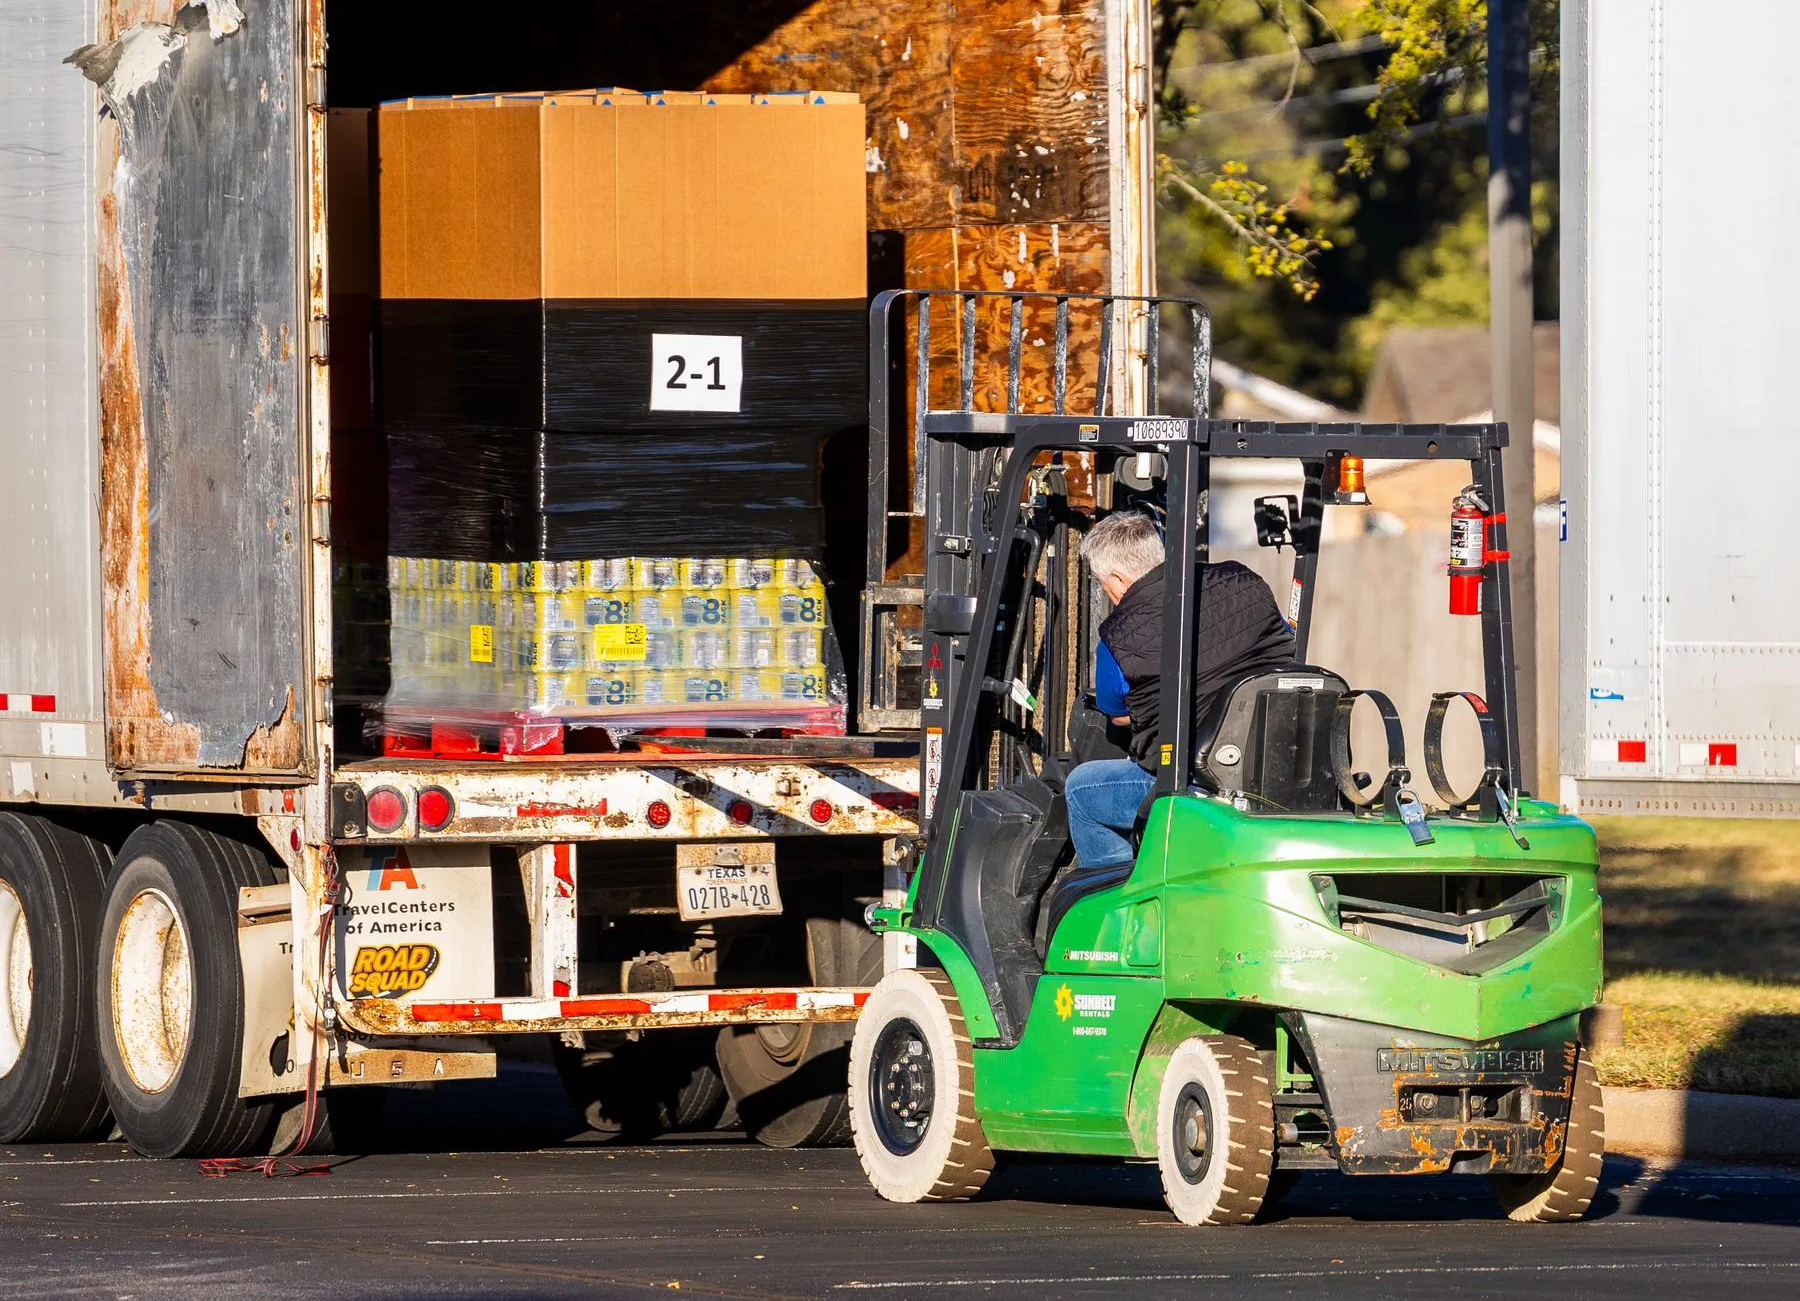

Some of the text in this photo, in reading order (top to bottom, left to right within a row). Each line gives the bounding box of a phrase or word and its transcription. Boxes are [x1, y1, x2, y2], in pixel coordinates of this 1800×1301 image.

[666, 354, 726, 390] 2-1
[1135, 420, 1187, 440] 10689390
[605, 600, 623, 625] 8
[702, 598, 721, 625] 8
[800, 597, 816, 623] 8
[606, 680, 625, 706] 8
[363, 845, 419, 891] TA
[707, 867, 746, 879] TEXAS
[725, 877, 749, 885] TRAILER
[334, 900, 455, 916] TravelCenters
[688, 884, 771, 910] 027B 428
[345, 919, 442, 934] of America
[353, 947, 431, 973] ROAD
[1069, 950, 1119, 962] MITSUBISHI
[349, 970, 427, 997] SQUAD
[1074, 994, 1117, 1011] SUNBELT
[1080, 1010, 1111, 1018] RENTALS
[350, 1057, 445, 1078] U S A
